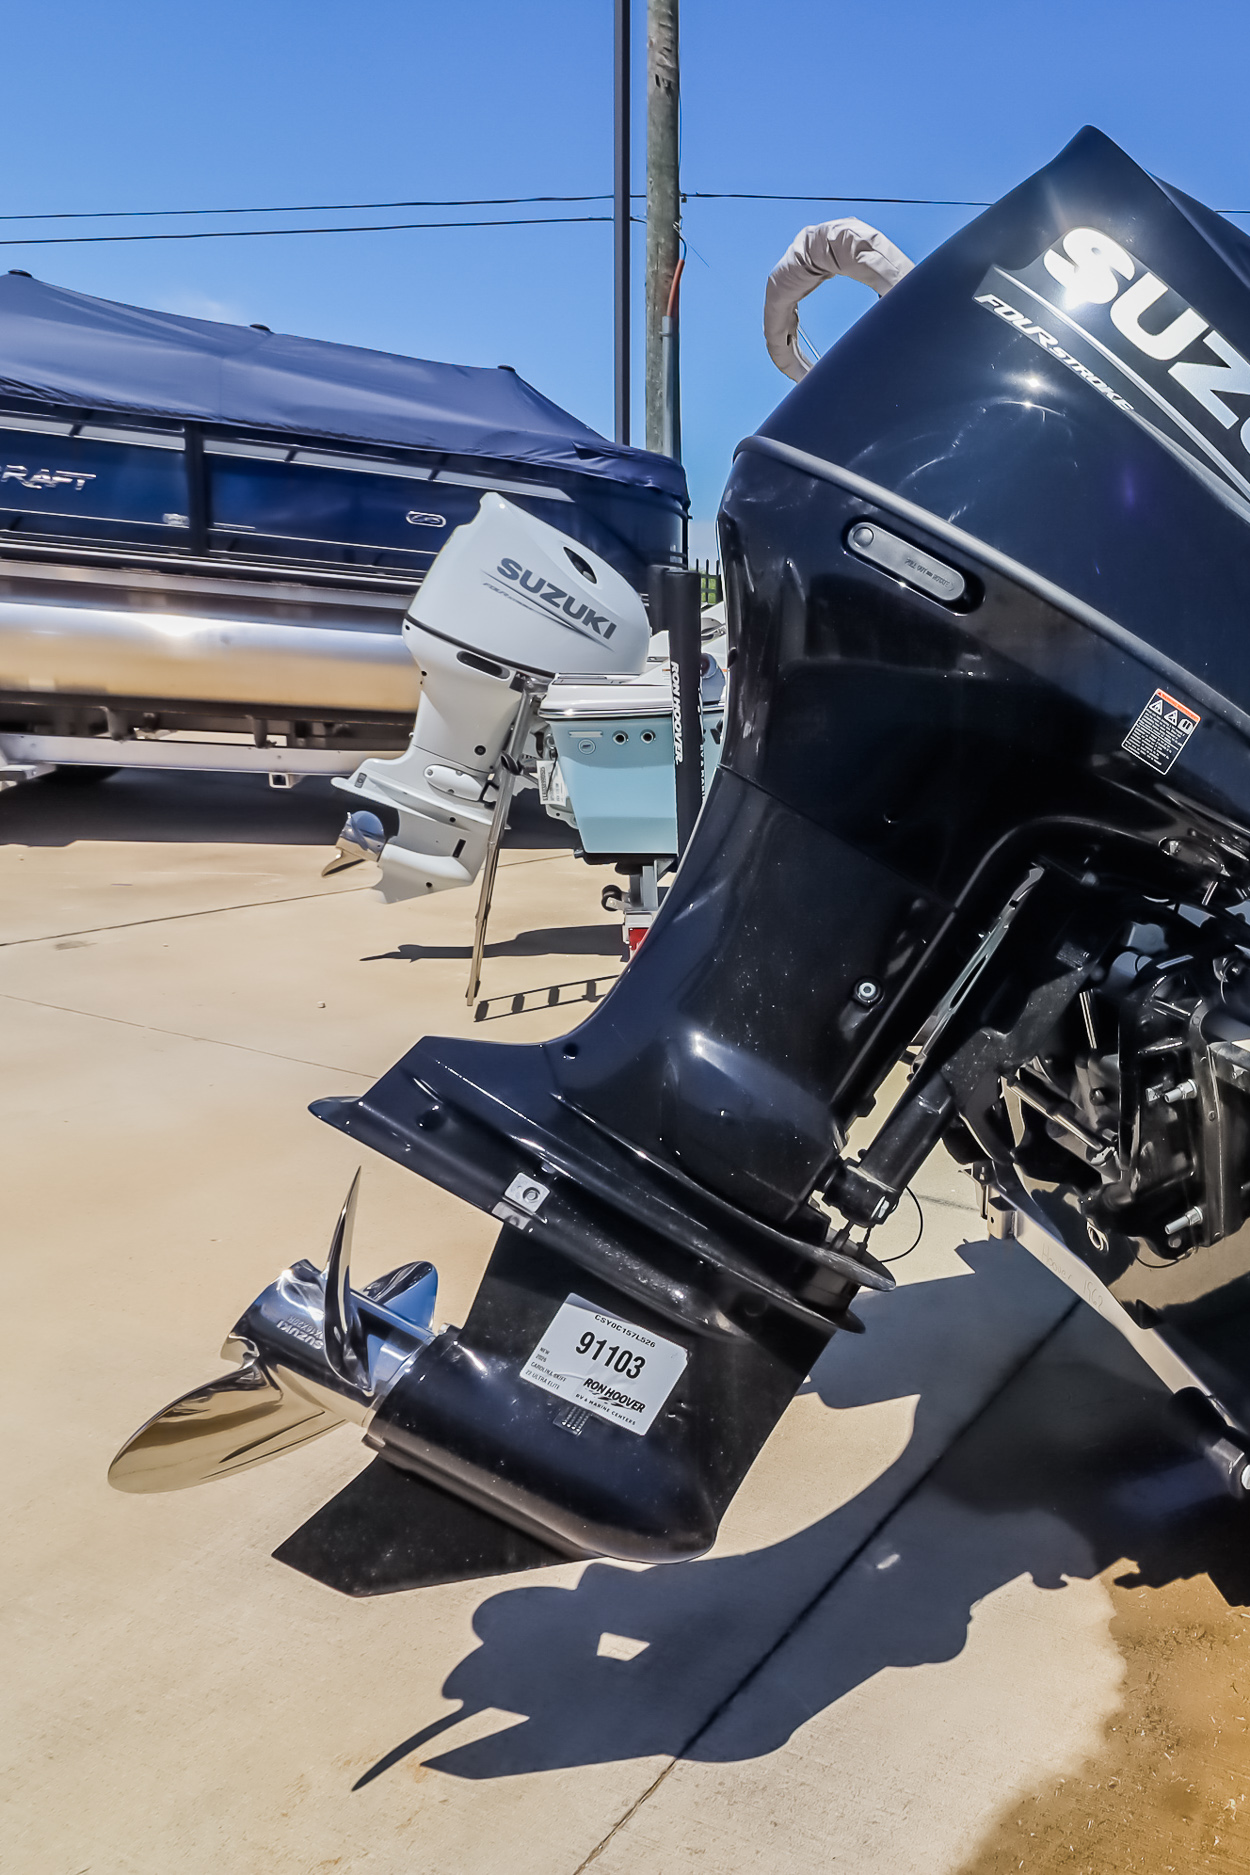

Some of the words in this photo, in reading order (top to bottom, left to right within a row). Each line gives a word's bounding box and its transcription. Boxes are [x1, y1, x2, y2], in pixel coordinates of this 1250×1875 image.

[0, 464, 97, 491] RAFT
[497, 557, 617, 640] SUZUKI
[671, 661, 681, 696] RON
[673, 697, 683, 765] HOOVER
[276, 1320, 324, 1350] SUZUKI
[575, 1331, 646, 1379] 91103
[583, 1377, 607, 1394] RON
[605, 1385, 646, 1413] HOOVER
[588, 1399, 610, 1413] MARINE
[611, 1410, 636, 1425] CENTERS
